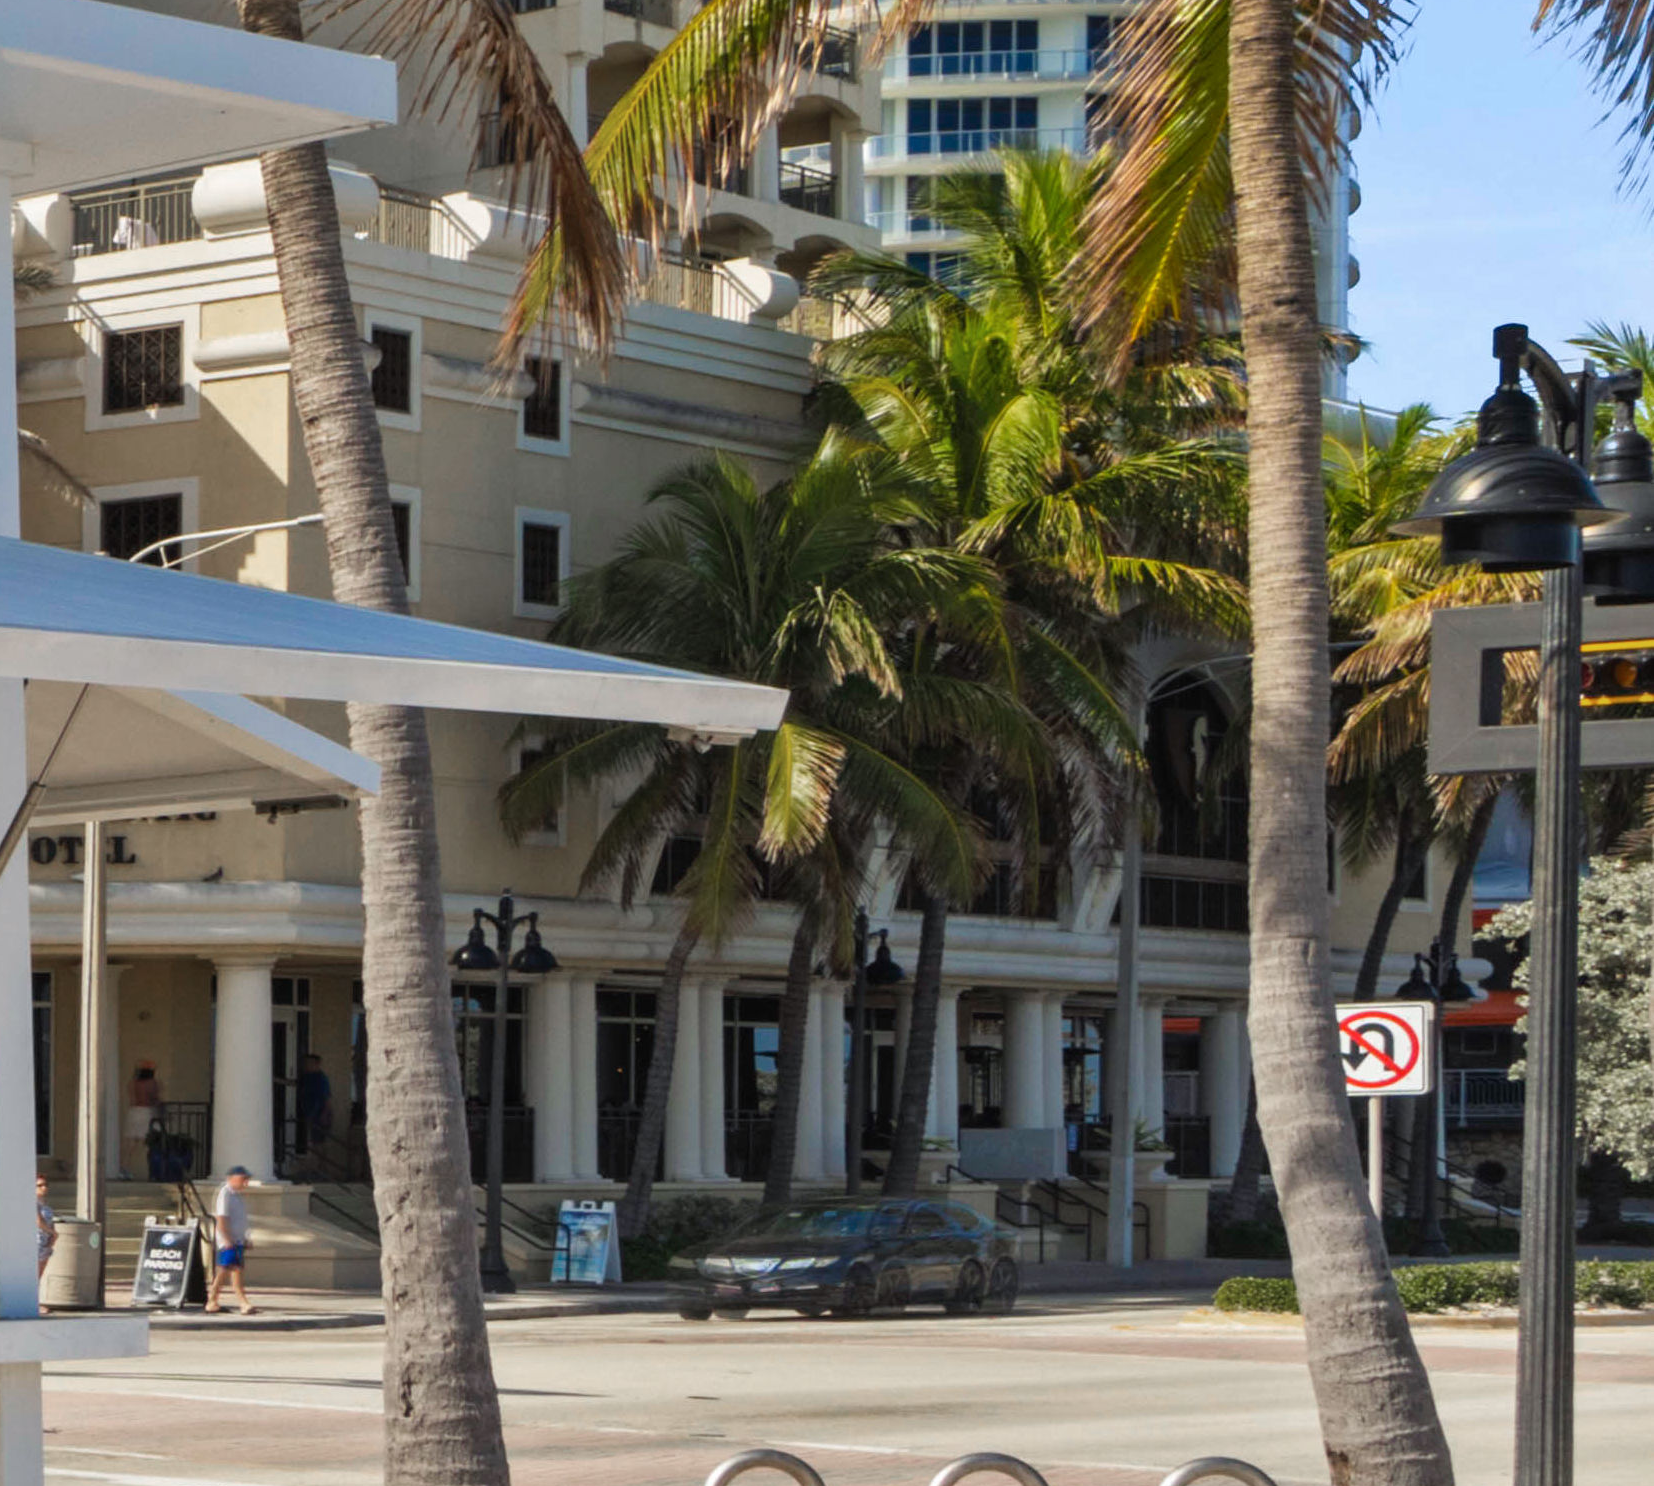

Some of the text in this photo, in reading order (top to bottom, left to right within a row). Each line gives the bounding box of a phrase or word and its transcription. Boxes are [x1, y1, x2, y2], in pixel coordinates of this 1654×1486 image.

[30, 835, 136, 864] OTL
[150, 1249, 182, 1260] BEACH
[143, 1259, 184, 1271] PARKING
